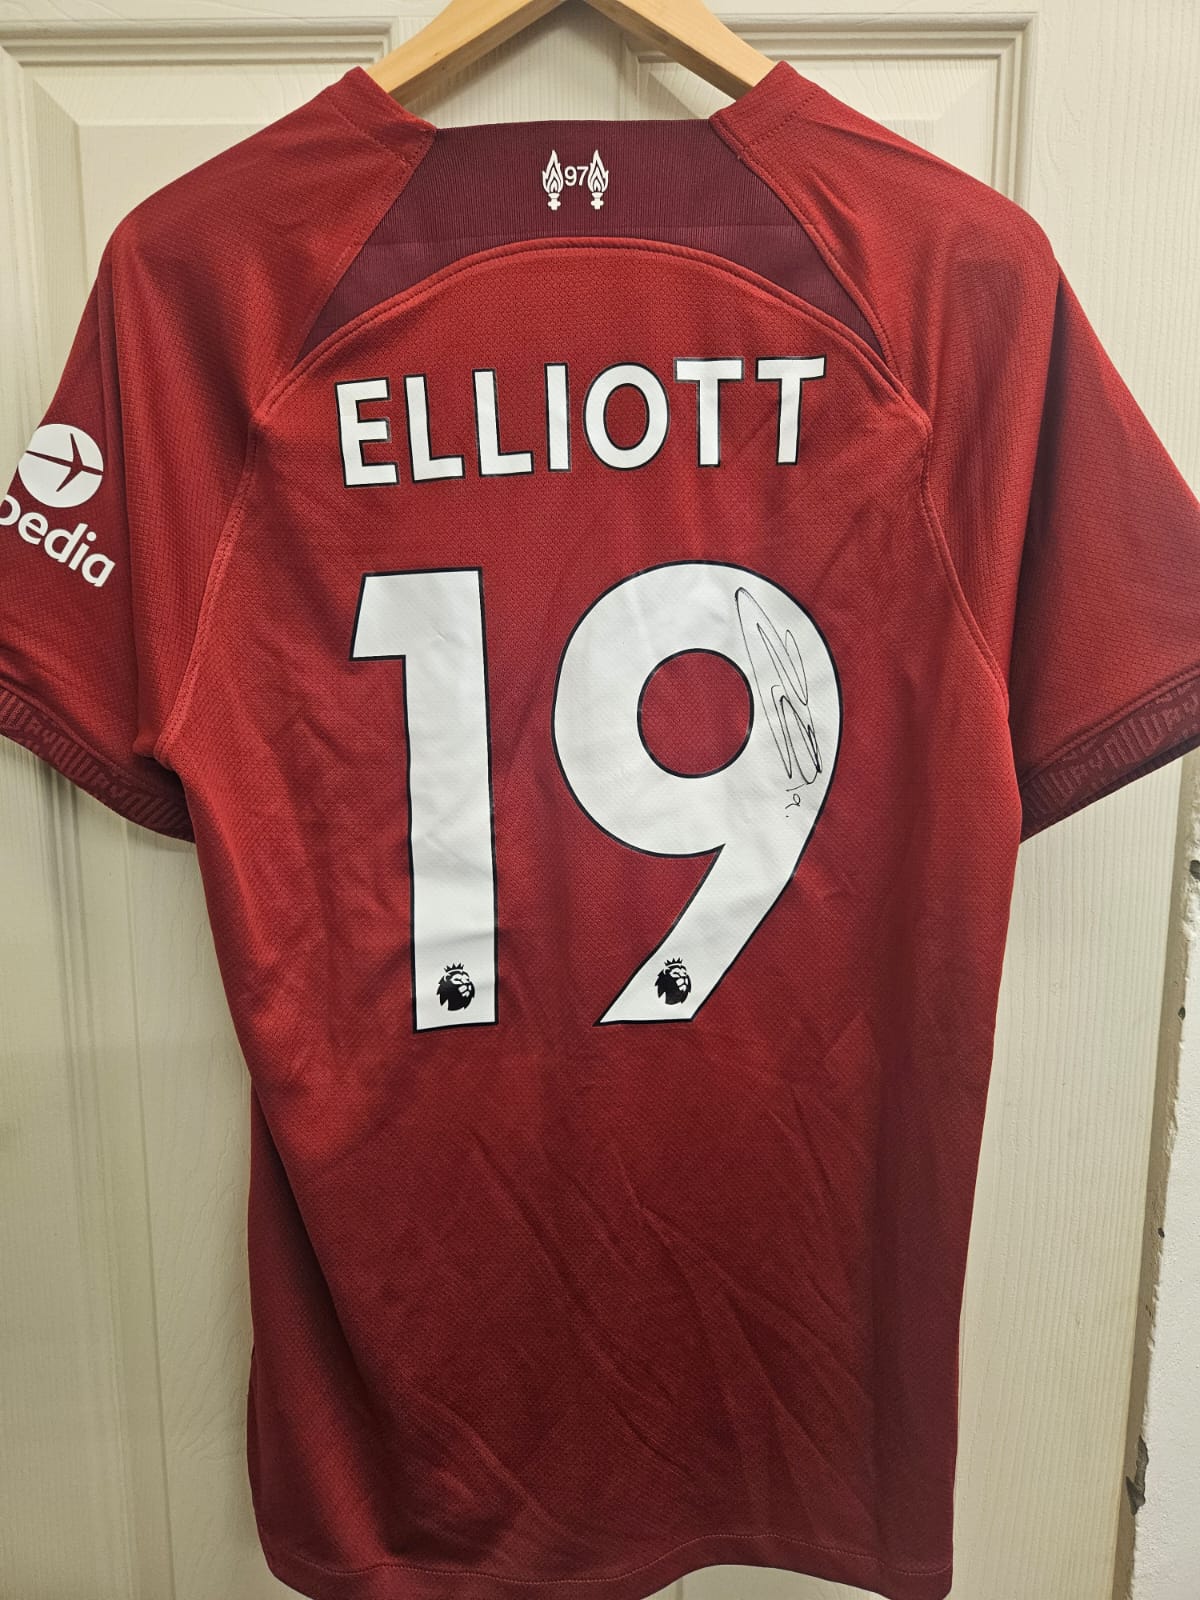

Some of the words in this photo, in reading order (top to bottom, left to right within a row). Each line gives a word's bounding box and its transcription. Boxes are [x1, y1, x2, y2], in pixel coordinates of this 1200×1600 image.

[564, 165, 589, 186] 97
[335, 355, 826, 488] ELLIOTT
[349, 560, 843, 1033] 19
